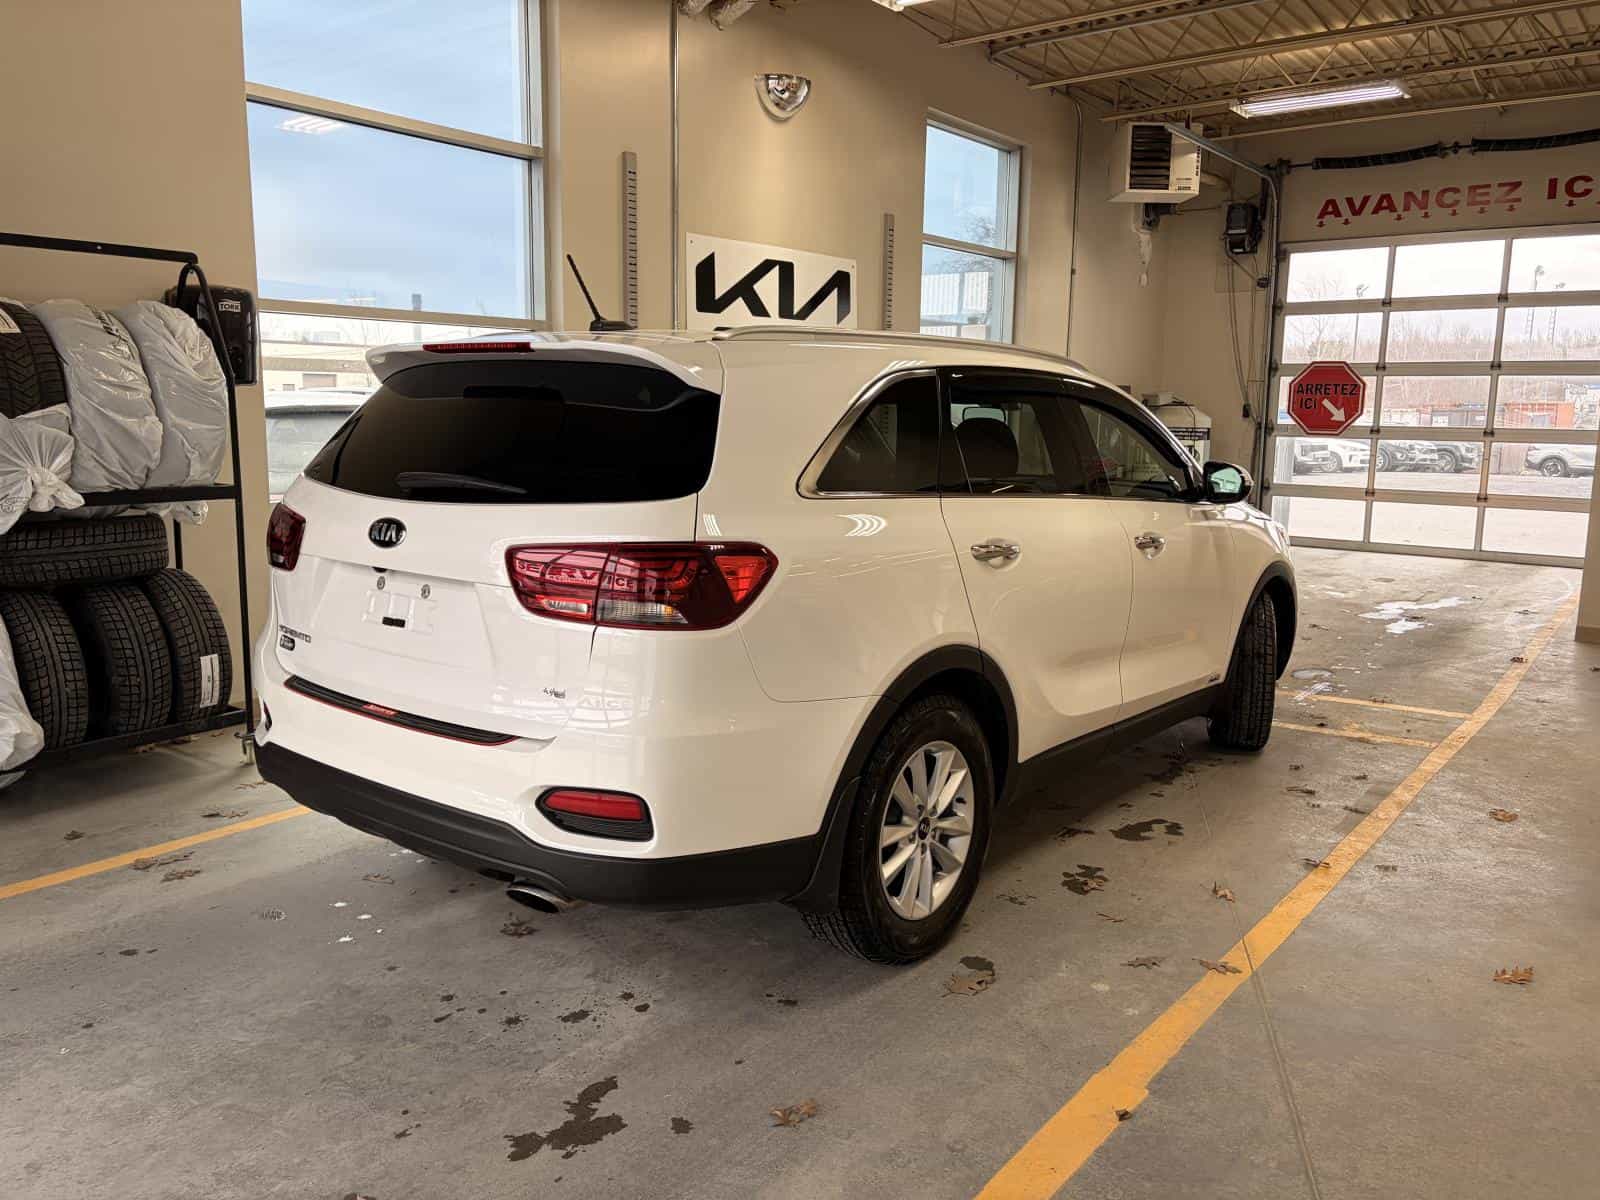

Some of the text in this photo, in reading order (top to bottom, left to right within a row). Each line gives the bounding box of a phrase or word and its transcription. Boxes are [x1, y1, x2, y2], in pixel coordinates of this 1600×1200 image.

[1316, 180, 1523, 220] AVANCEZ
[695, 251, 851, 326] KIA
[1296, 383, 1359, 396] ARRETEZ
[1300, 397, 1317, 410] ICI
[371, 522, 397, 542] KIA
